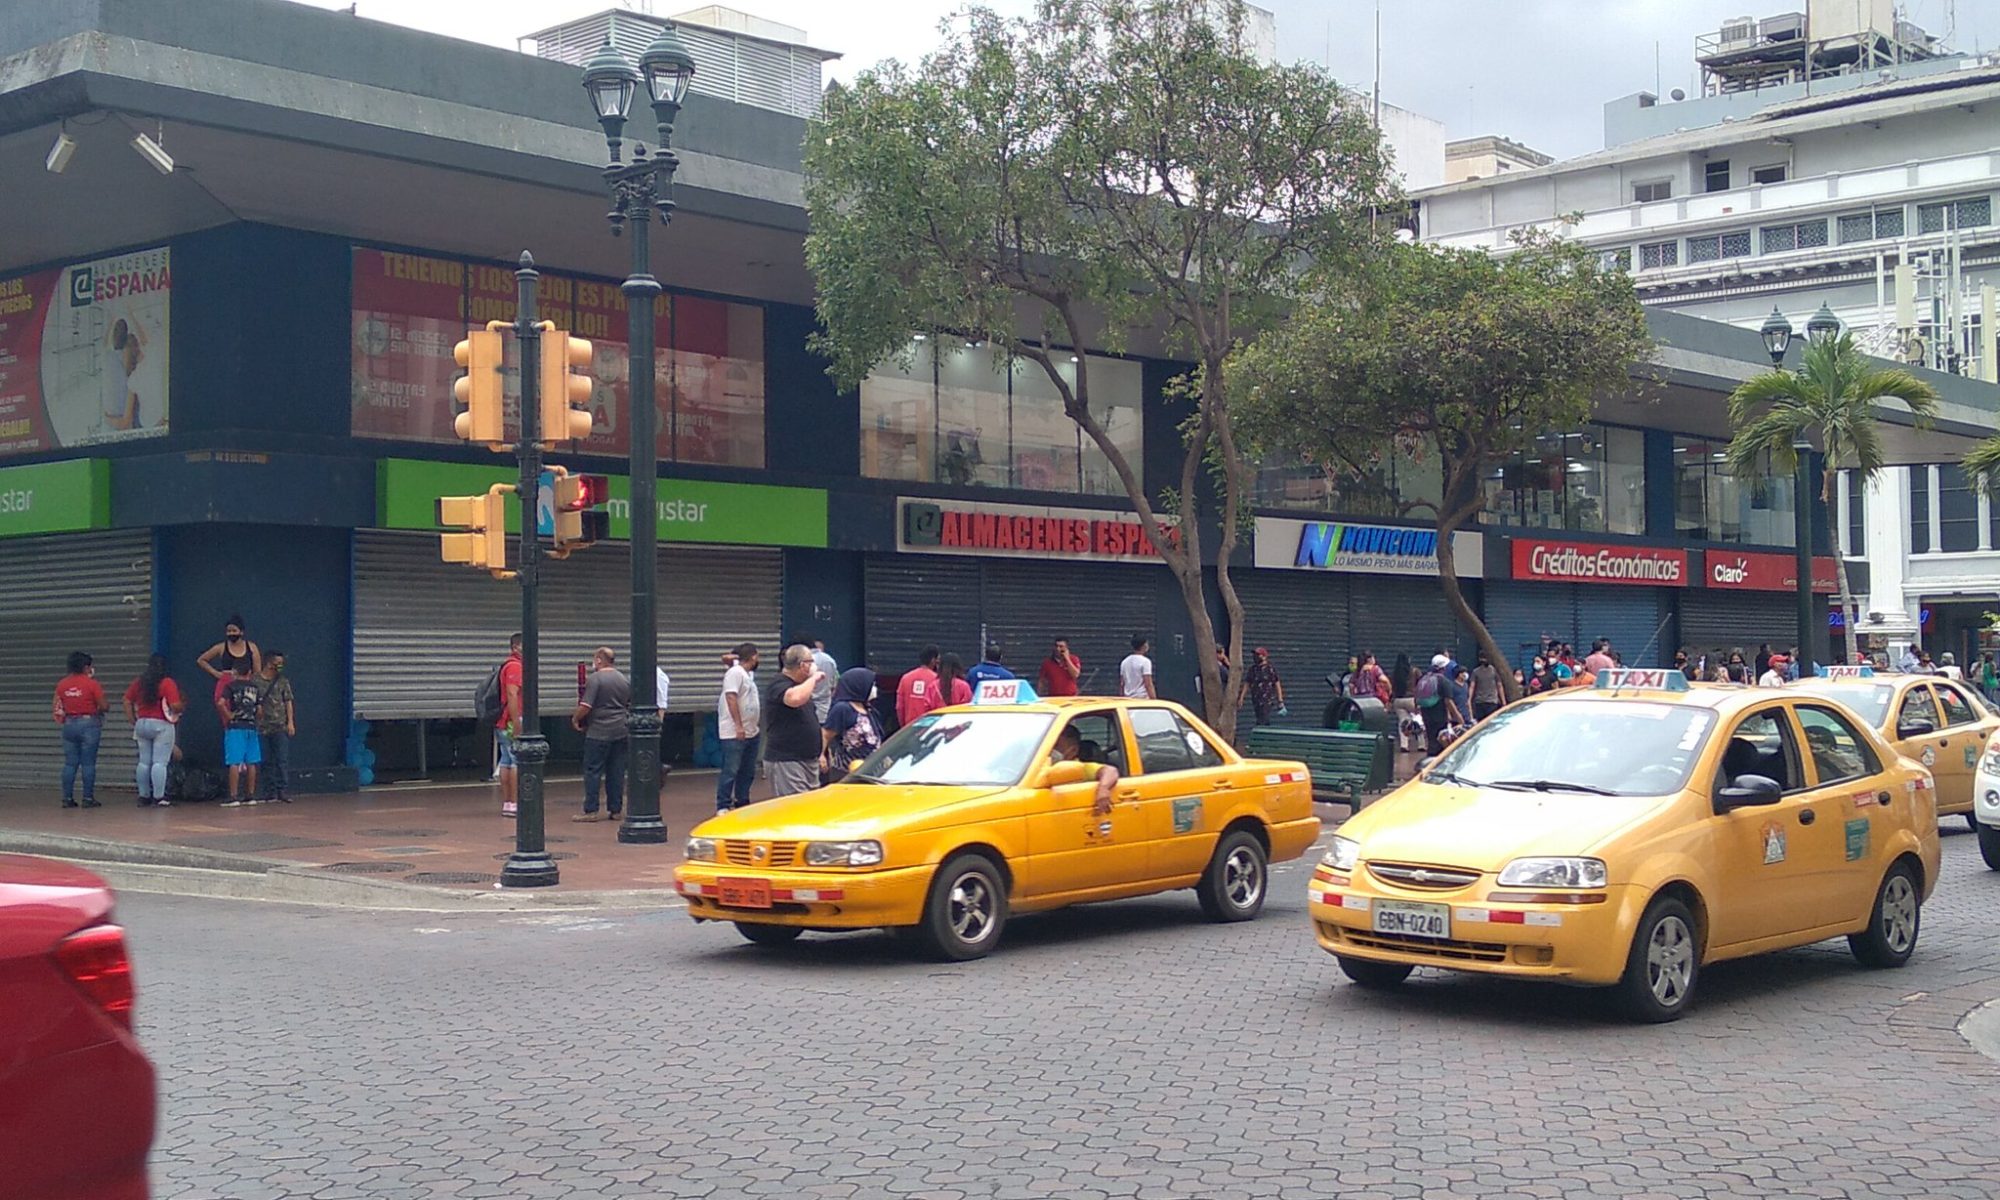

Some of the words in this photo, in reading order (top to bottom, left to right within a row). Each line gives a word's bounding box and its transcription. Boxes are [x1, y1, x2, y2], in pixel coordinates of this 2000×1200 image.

[95, 266, 172, 301] ESPAÑA
[479, 269, 514, 295] LOS
[941, 511, 1091, 553] ALMACENES
[1334, 556, 1345, 566] LO
[1345, 557, 1373, 568] MISMO
[1374, 558, 1395, 569] PERO
[1531, 545, 1596, 577] Créditos
[1597, 549, 1680, 581] Económicos
[1714, 563, 1743, 583] Claro
[1610, 670, 1665, 688] TAXI
[1830, 667, 1860, 678] TAXI
[983, 684, 1017, 699] TAXI
